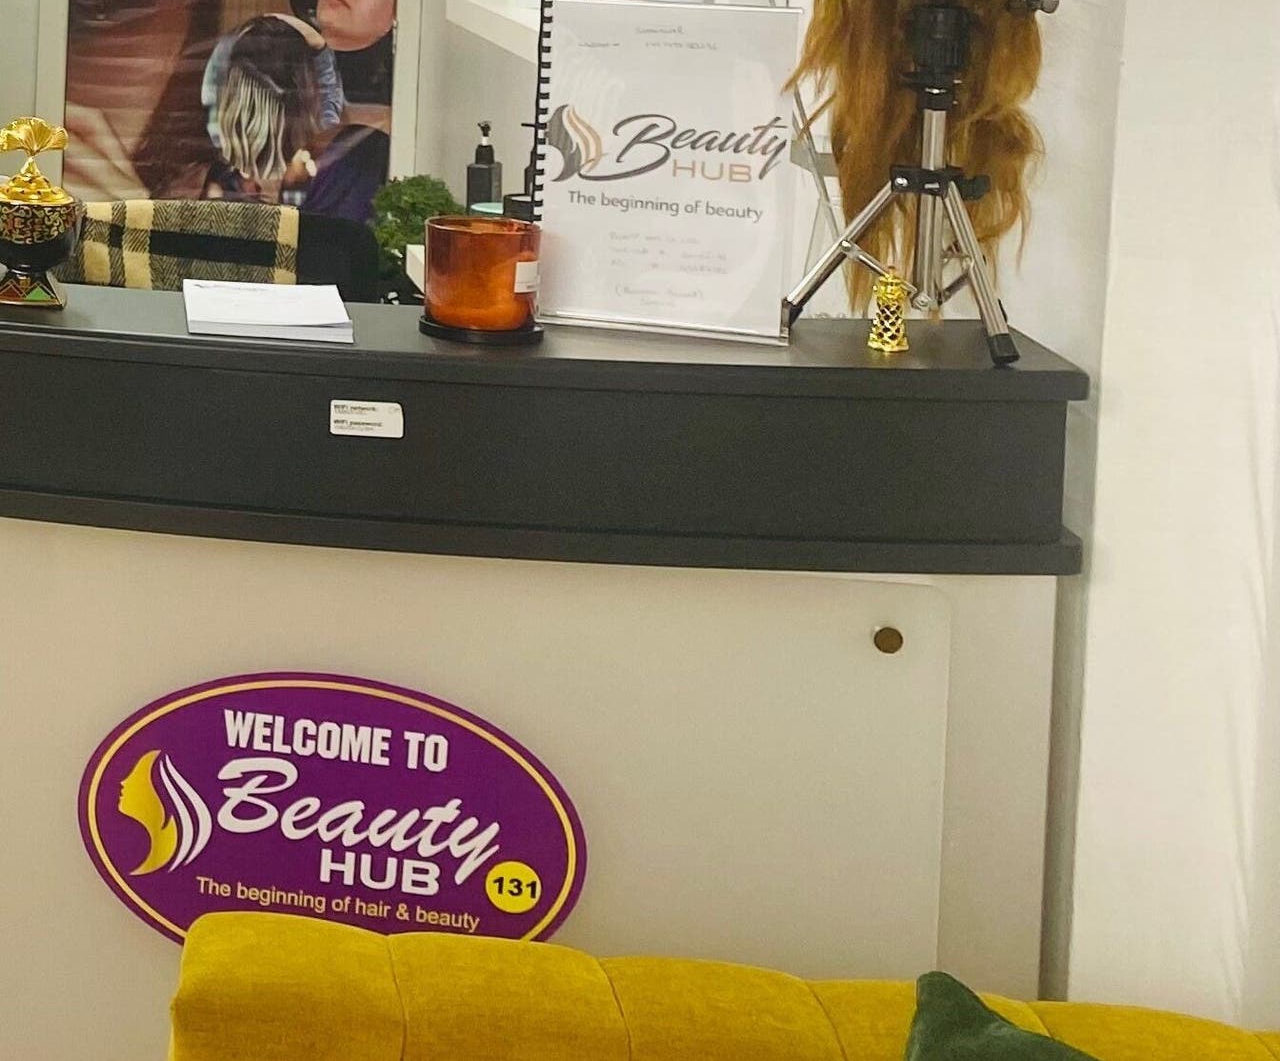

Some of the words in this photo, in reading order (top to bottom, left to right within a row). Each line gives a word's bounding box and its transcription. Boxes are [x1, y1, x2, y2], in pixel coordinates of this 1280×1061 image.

[580, 113, 788, 181] Beauty
[672, 161, 752, 183] HUB
[568, 190, 597, 207] The
[601, 192, 680, 216] beginning
[685, 200, 704, 215] of
[706, 202, 764, 222] beauty
[224, 709, 392, 765] WELCOME
[405, 732, 448, 772] TO
[218, 758, 500, 886] Beauty
[319, 848, 440, 895] HUB
[493, 875, 537, 900] 131
[196, 876, 231, 897] The
[237, 881, 325, 914] beginning
[332, 895, 351, 914] of
[354, 899, 391, 919] hair
[396, 903, 410, 920] &
[416, 905, 480, 933] beauty
